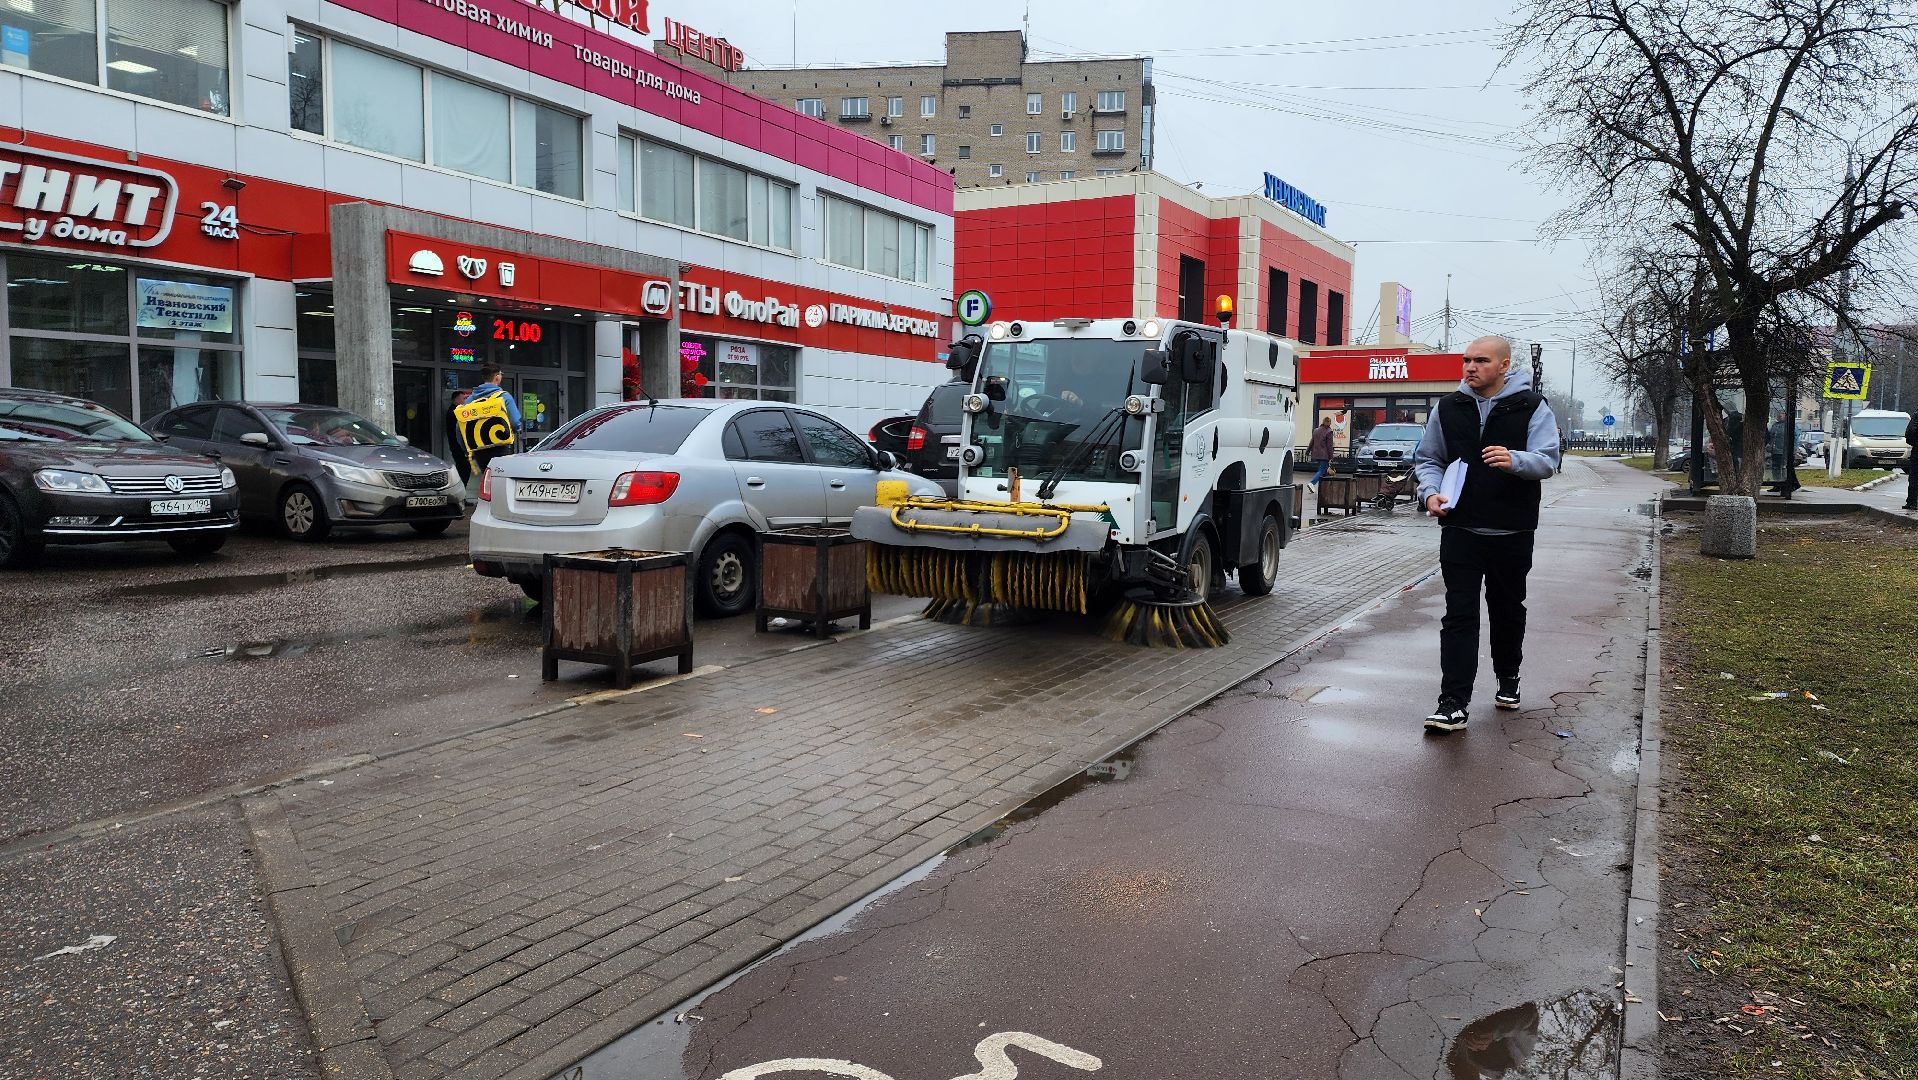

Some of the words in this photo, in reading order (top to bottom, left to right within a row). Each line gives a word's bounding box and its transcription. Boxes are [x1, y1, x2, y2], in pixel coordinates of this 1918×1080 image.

[427, 0, 491, 26] овая
[495, 14, 553, 49] химия
[664, 16, 745, 72] ЦЕНТР
[573, 44, 632, 78] товары
[635, 69, 663, 91] для
[665, 81, 701, 105] дома
[201, 201, 239, 228] 24
[23, 217, 48, 241] у
[50, 216, 127, 246] дома
[201, 225, 239, 239] ЧАСА
[146, 295, 226, 312] Ивановский
[155, 307, 218, 321] Текстиль
[724, 290, 800, 329] ФлоРай
[966, 299, 979, 317] F
[493, 319, 541, 342] 21.00
[830, 302, 939, 338] ПАРИКМАХЕРСКАЯ
[730, 345, 746, 354] РОЗА
